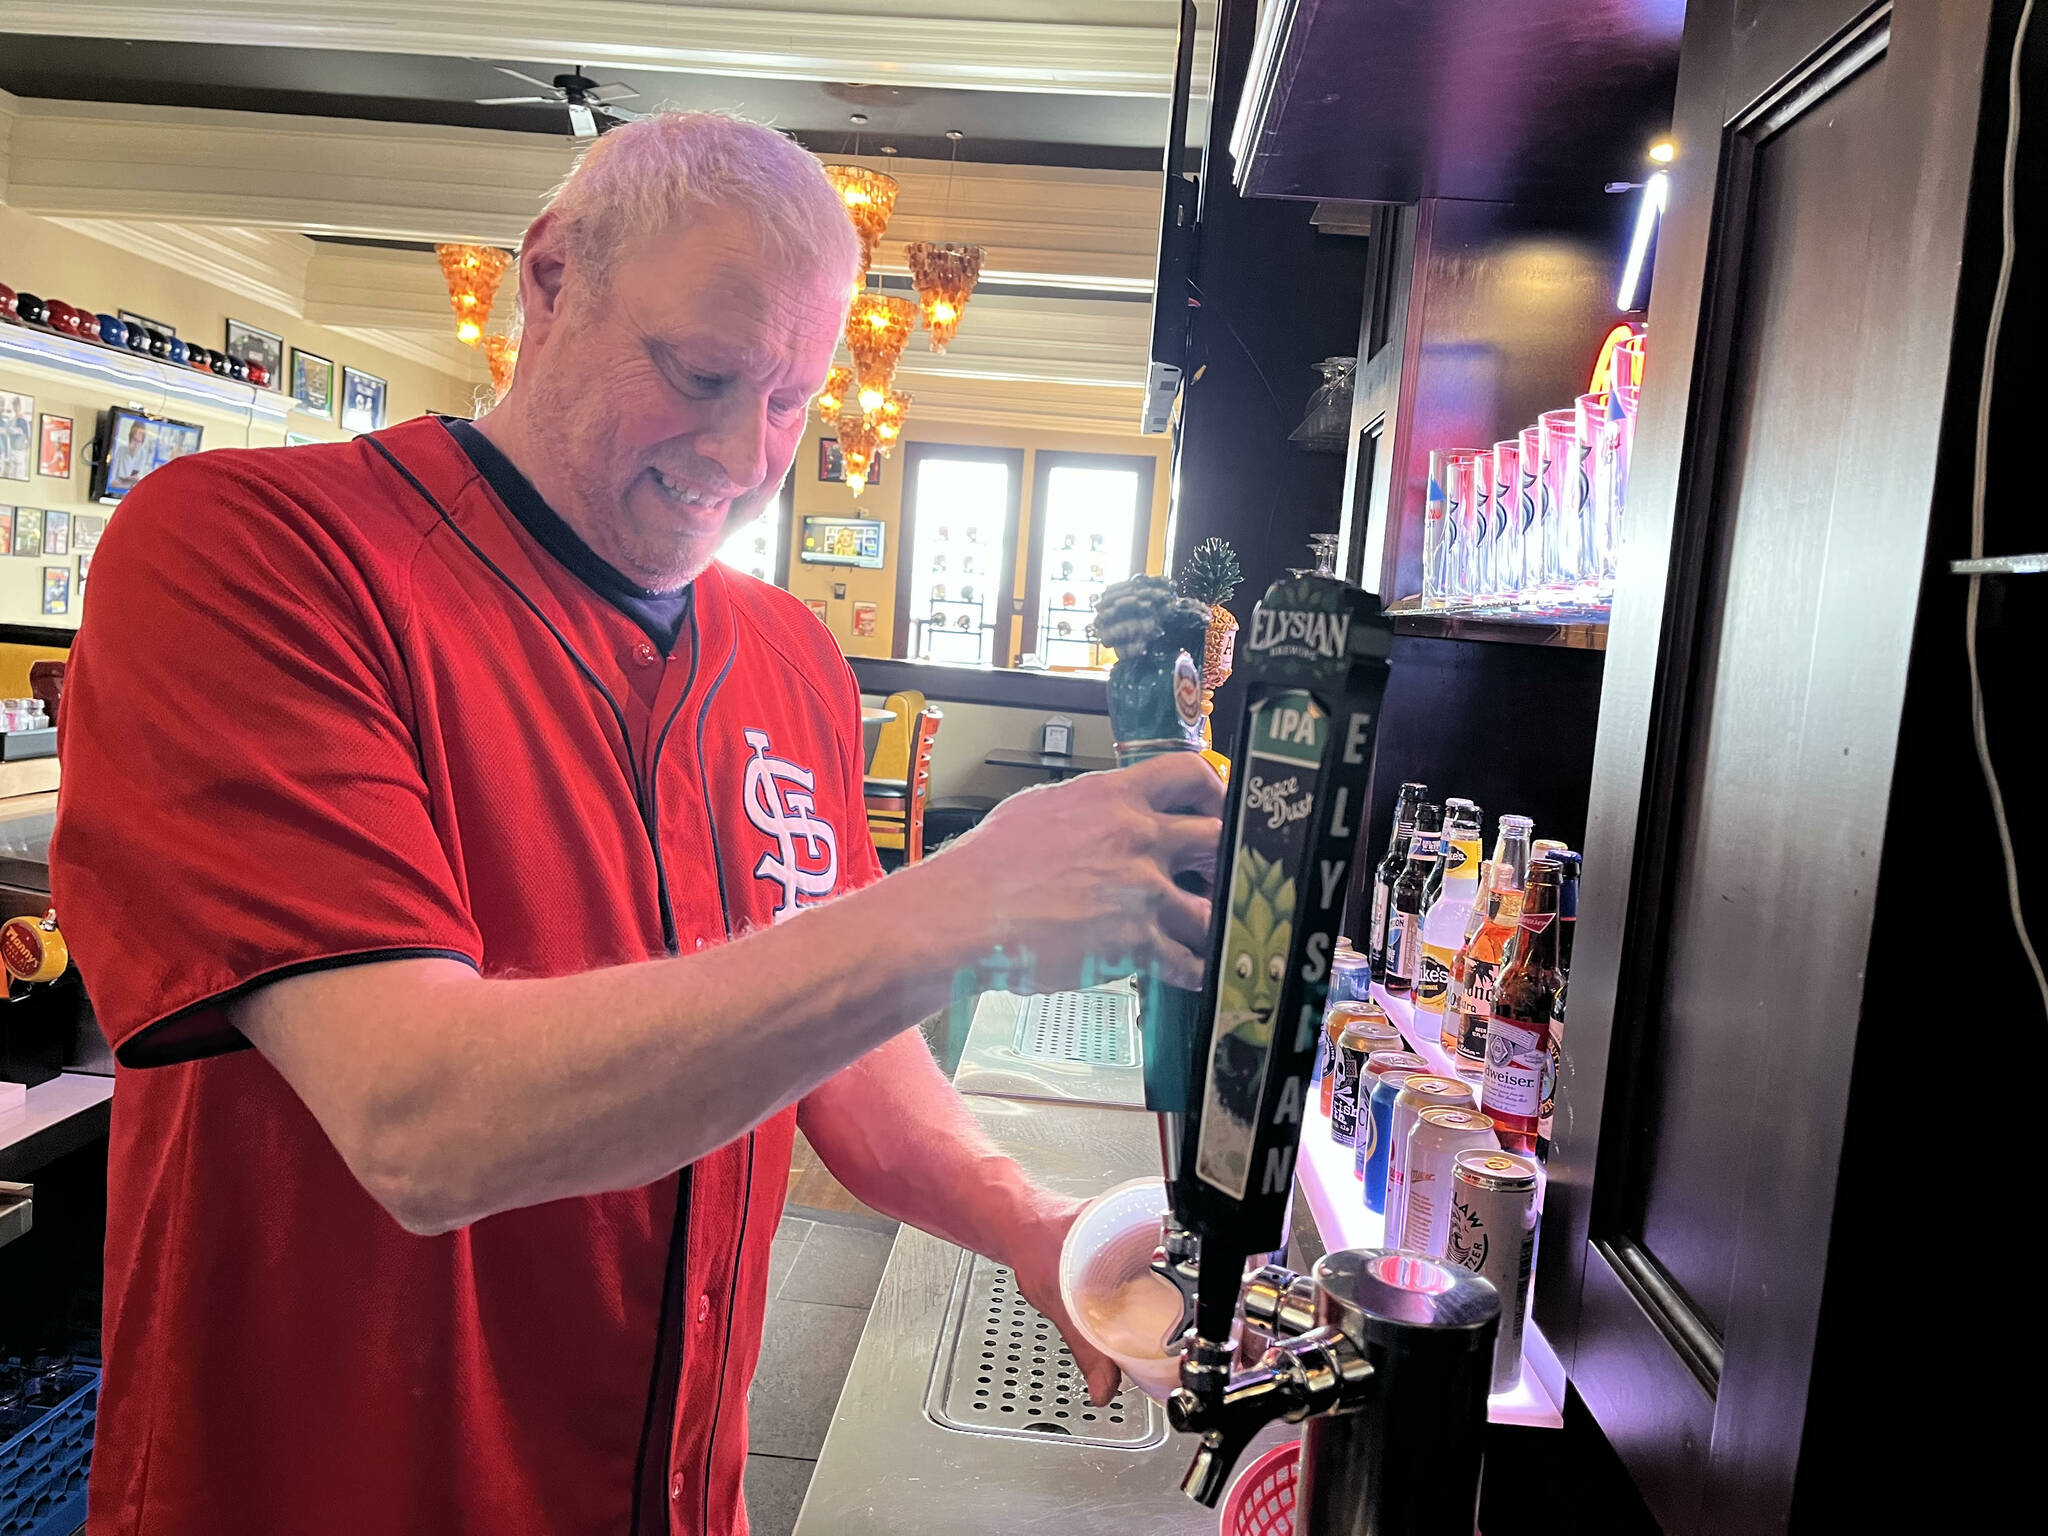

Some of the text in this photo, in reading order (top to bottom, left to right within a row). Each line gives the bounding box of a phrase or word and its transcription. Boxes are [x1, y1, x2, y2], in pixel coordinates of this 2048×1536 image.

[1250, 609, 1349, 659] ELYSIAN
[1269, 707, 1316, 746] IPA
[1247, 776, 1299, 813] Space
[1267, 792, 1315, 830] Dust
[1453, 1191, 1484, 1229] LAW
